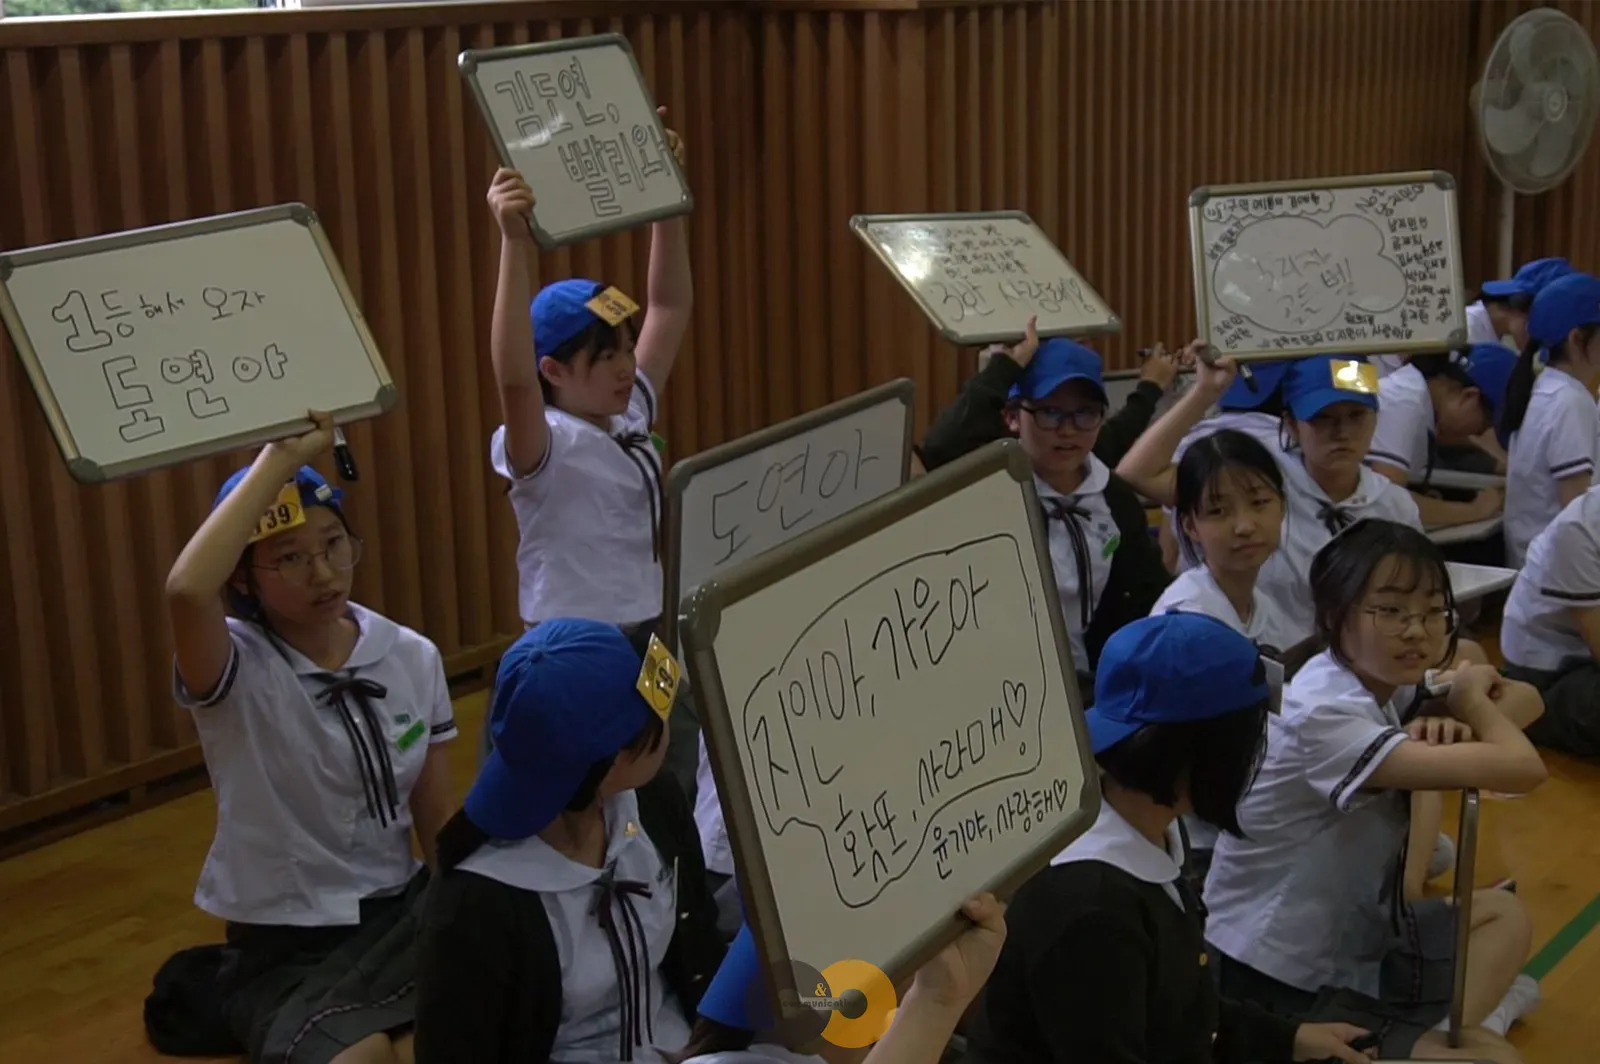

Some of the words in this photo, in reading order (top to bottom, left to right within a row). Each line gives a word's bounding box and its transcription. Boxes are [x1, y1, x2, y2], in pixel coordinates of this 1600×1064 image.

[201, 286, 266, 320] 오자
[102, 343, 289, 443] 도연아
[711, 429, 879, 566] 도연아
[872, 564, 990, 681] 가은아
